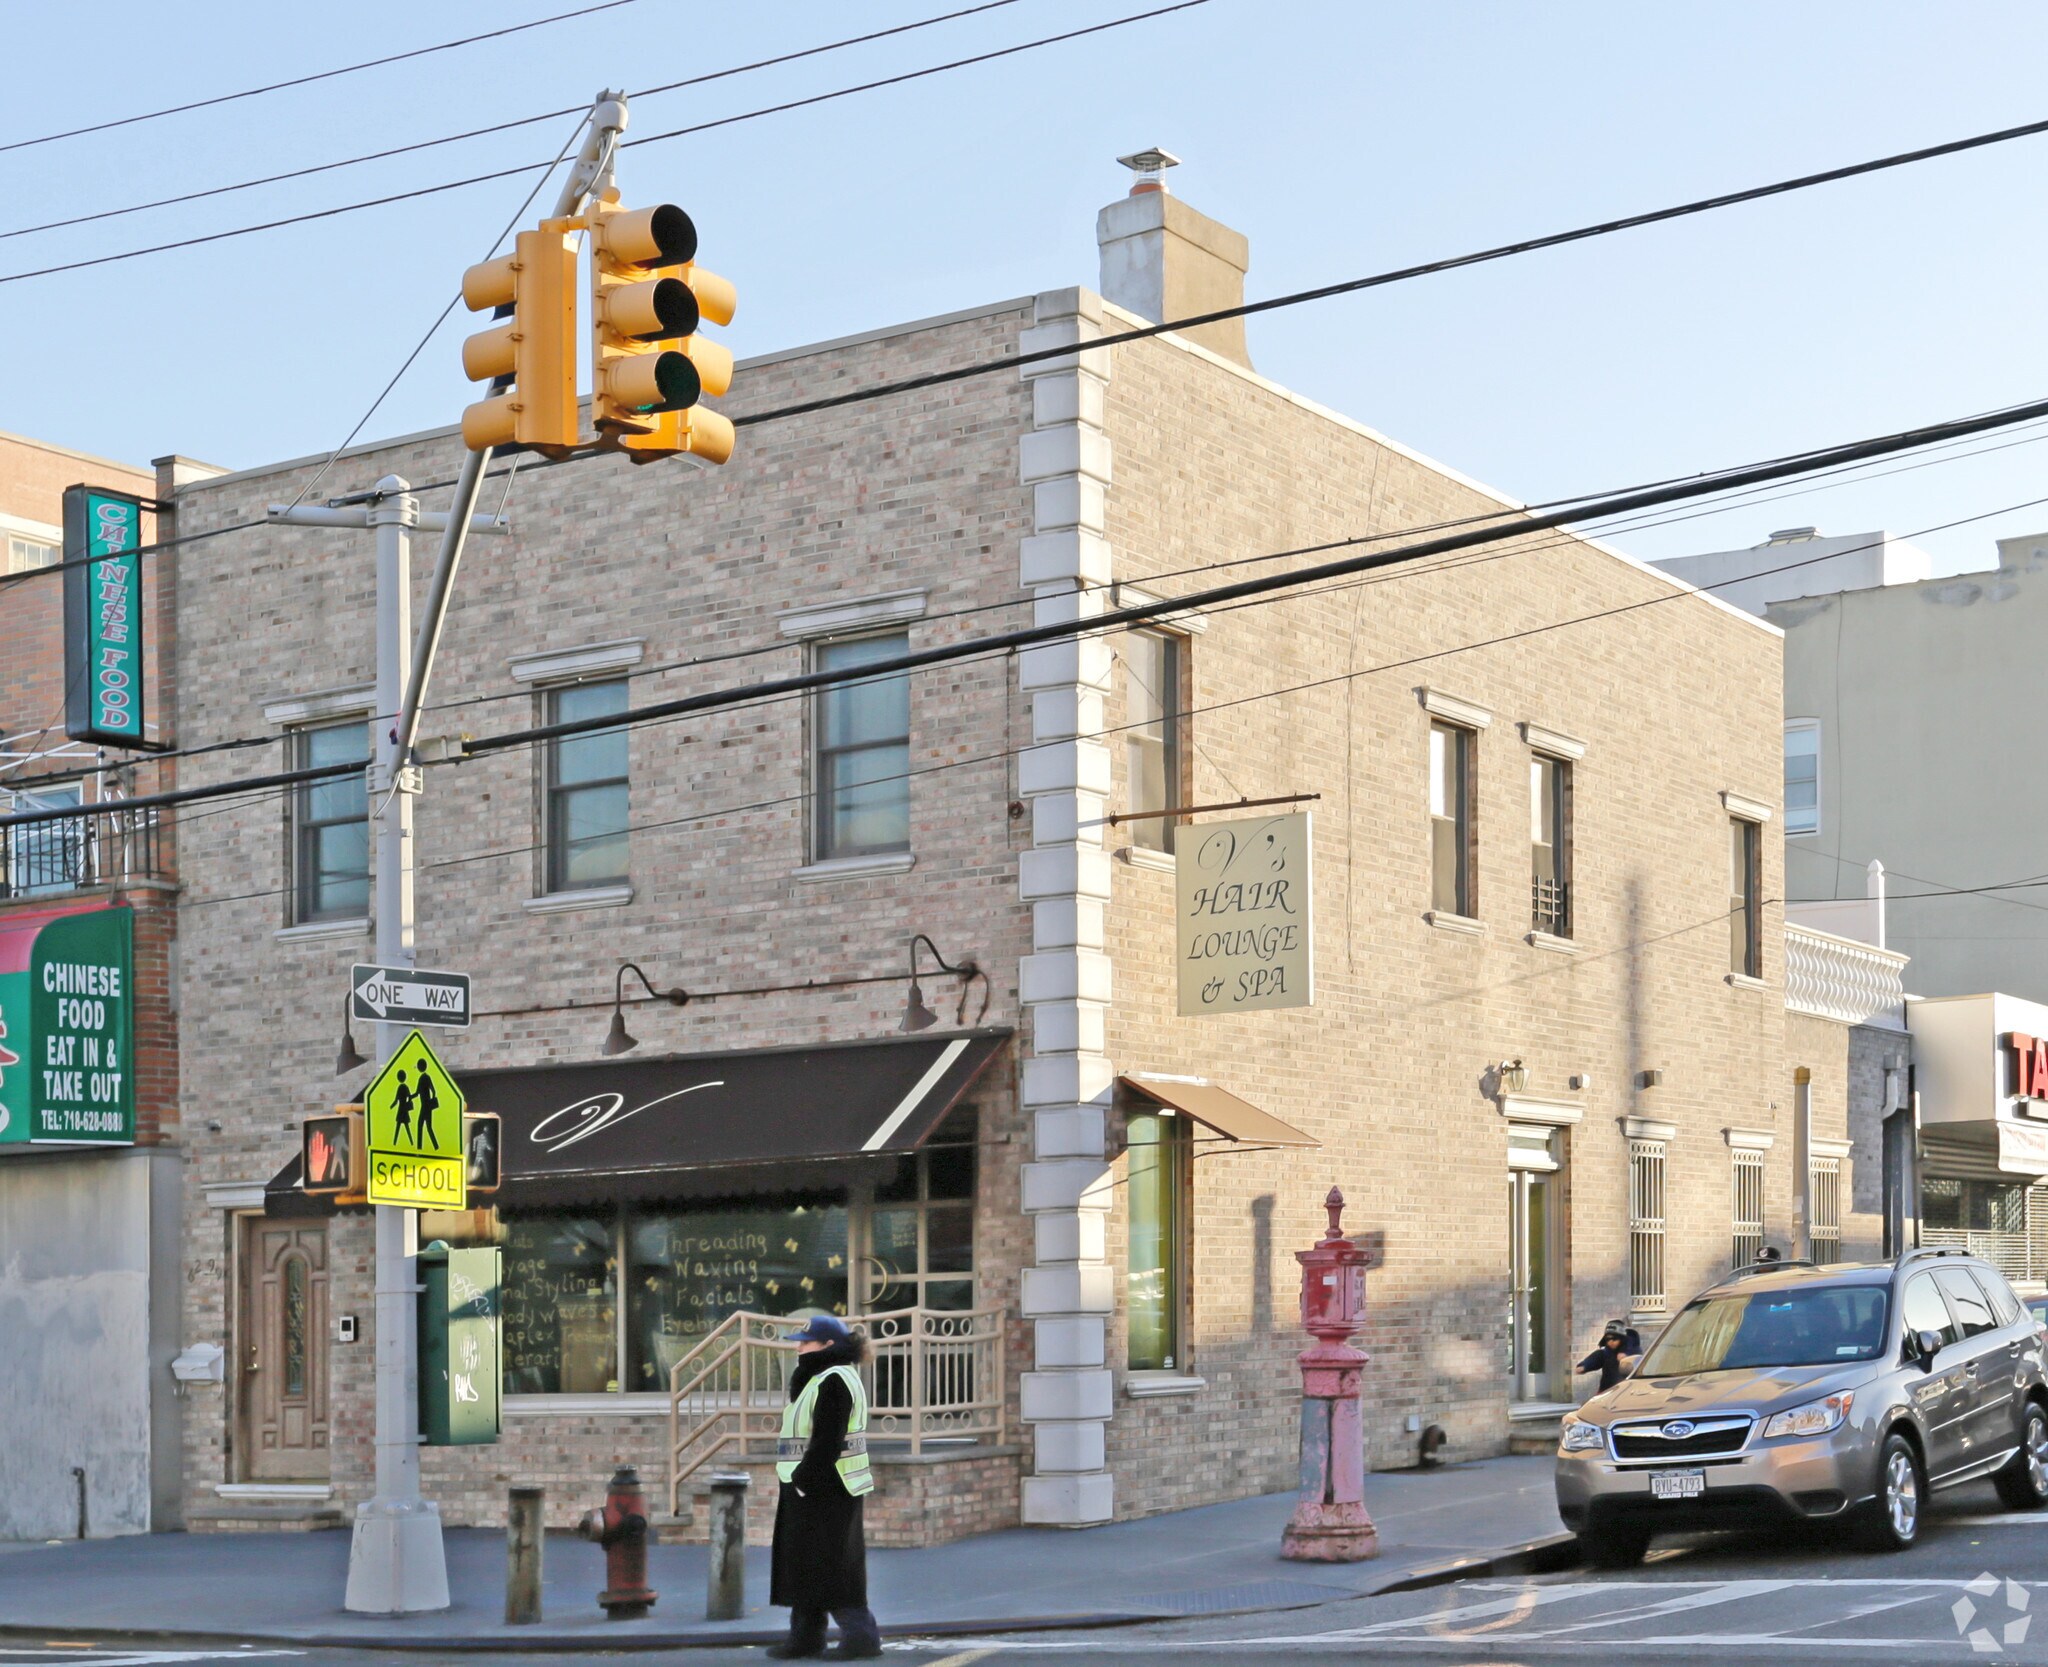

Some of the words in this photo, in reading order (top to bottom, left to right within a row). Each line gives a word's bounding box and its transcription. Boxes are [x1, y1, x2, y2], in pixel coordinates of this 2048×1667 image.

[97, 504, 129, 642] CHINESE
[99, 648, 130, 728] FOOD
[1198, 818, 1287, 879] V's
[1190, 879, 1296, 917] HAIR
[1187, 923, 1298, 961] LOUNGE
[43, 962, 120, 997] CHINESE
[366, 983, 404, 1005] ONE
[424, 987, 460, 1009] WAY
[1201, 976, 1225, 1003] &
[1233, 965, 1288, 1003] SPA
[58, 998, 105, 1030] FOOD
[47, 1035, 75, 1066] EAT
[83, 1037, 98, 1067] IN
[106, 1038, 117, 1068] &
[43, 1070, 83, 1101] TAKE
[90, 1073, 122, 1103] OUT
[41, 1109, 62, 1131] TEL:
[376, 1161, 458, 1192] SCHOOL
[656, 1229, 768, 1258] Threading
[674, 1253, 758, 1283] Waxing
[676, 1284, 755, 1307] Facials
